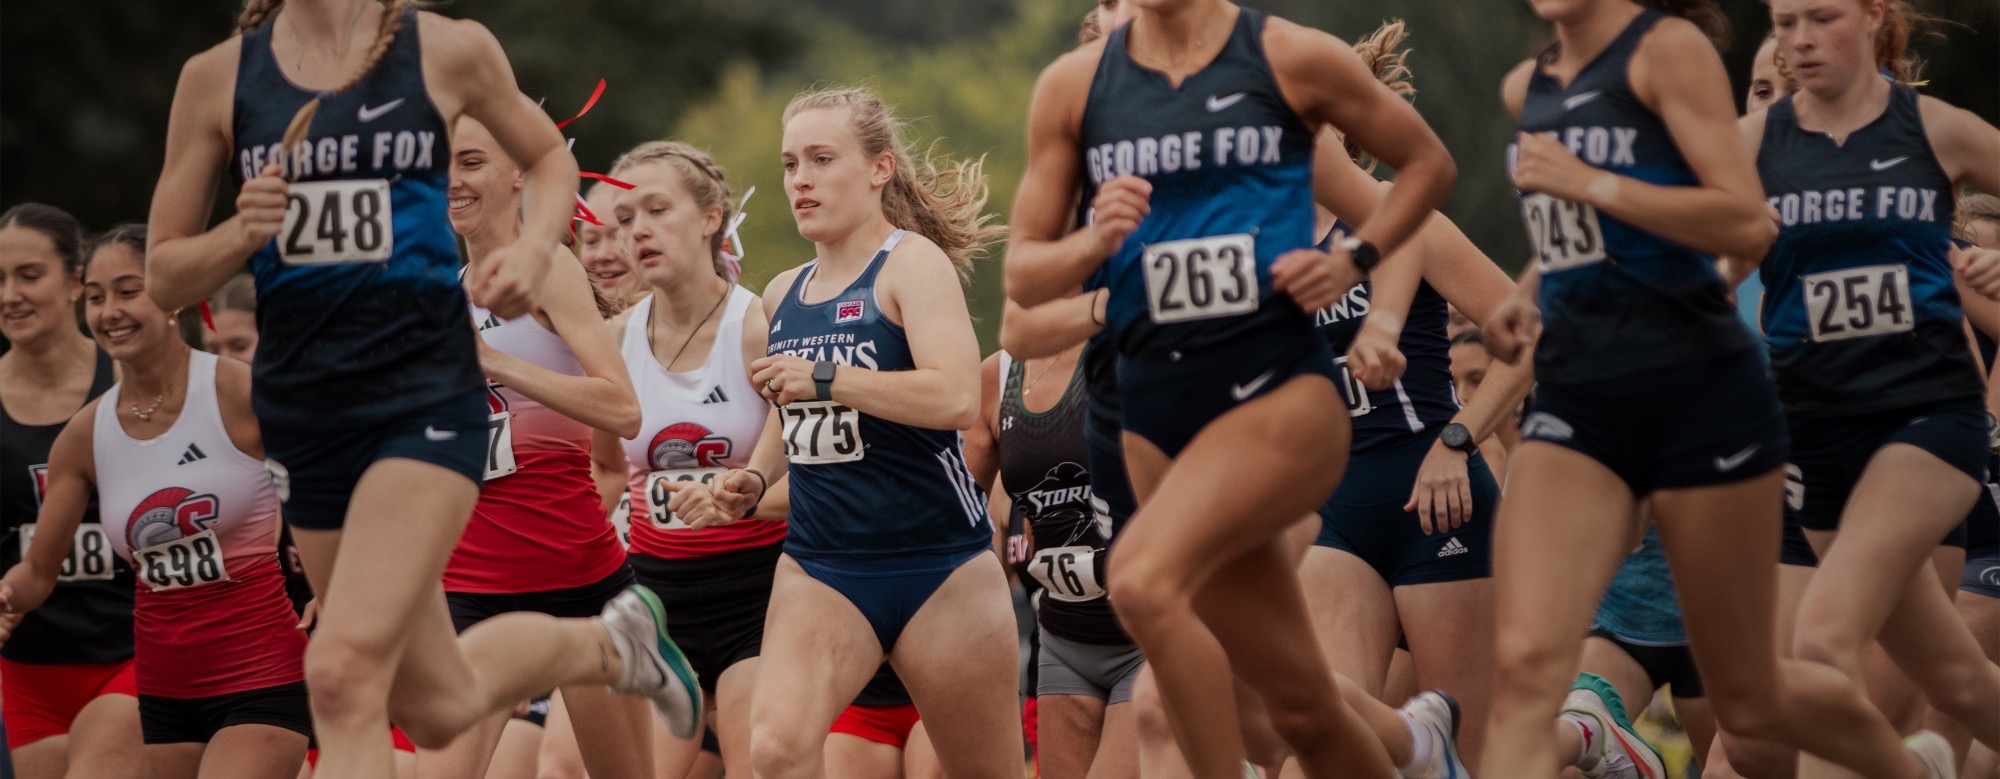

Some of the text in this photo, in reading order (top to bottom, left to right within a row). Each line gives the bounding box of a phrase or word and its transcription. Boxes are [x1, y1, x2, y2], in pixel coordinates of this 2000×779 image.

[241, 130, 435, 181] GEORGE FOX
[1087, 126, 1283, 183] GEORGE FOX
[1564, 125, 1638, 166] FOX
[285, 189, 383, 255] 248
[1878, 186, 1937, 222] FOX
[1530, 200, 1597, 263] 243
[1154, 243, 1249, 312] 263
[1813, 271, 1905, 335] 254
[768, 333, 855, 354] TRINITY WESTERN
[786, 404, 857, 457] 775
[143, 536, 221, 587] 698
[1040, 552, 1086, 597] 76
[1438, 547, 1468, 557] adidas
